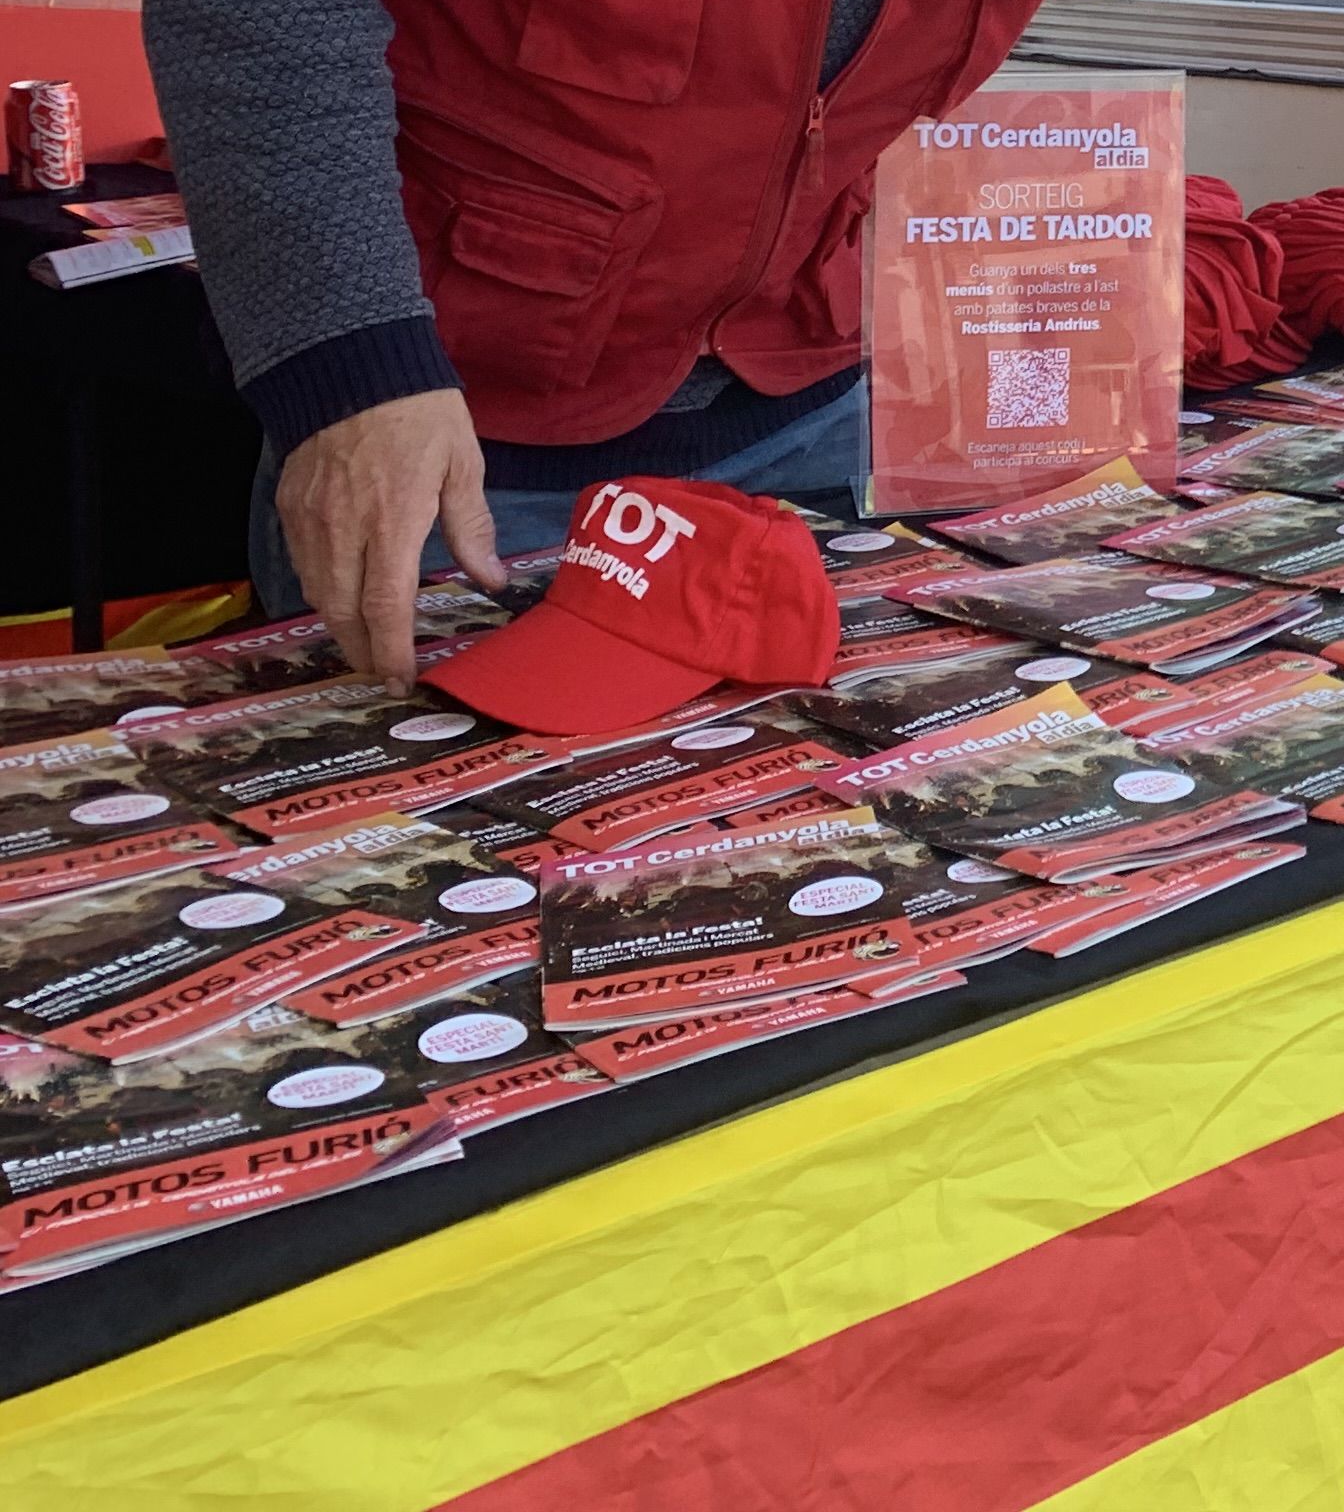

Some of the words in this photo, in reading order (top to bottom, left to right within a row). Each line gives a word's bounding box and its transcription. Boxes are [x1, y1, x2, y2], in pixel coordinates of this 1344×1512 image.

[913, 123, 979, 148] TOT
[981, 122, 1137, 153] Cerdanyola
[979, 183, 1084, 210] SORTEIG
[906, 216, 993, 243] FESTA
[1000, 215, 1037, 242] DE
[1043, 213, 1153, 241] TARDOR
[946, 284, 994, 297] menús
[1026, 281, 1081, 296] pollastre
[970, 263, 1017, 279] Guanya
[1020, 265, 1037, 276] un
[1039, 263, 1066, 275] dels
[1068, 262, 1097, 275] tres
[954, 302, 983, 316] amb
[985, 302, 1034, 317] patates
[1036, 300, 1078, 314] braves
[1080, 299, 1097, 312] de
[1099, 298, 1111, 311] la
[961, 319, 1042, 335] Rostisseria
[581, 483, 697, 564] TOT
[1000, 479, 1130, 527] Cerdanyola
[565, 538, 650, 601] Cerdanyola
[213, 632, 284, 654] TOT
[836, 758, 908, 789] TOT
[910, 707, 1072, 767] Cerdanyola
[266, 781, 404, 823] MOTOS
[582, 785, 706, 832] MOTOS
[556, 856, 643, 880] TOT
[646, 819, 850, 866] Cerdanyola
[571, 936, 660, 958] Esclata
[665, 929, 687, 941] la
[691, 916, 763, 936] Festa!
[84, 973, 236, 1039] MOTOS
[244, 919, 365, 973] FURIÓ
[324, 945, 472, 1004] MOTOS
[572, 965, 736, 1003] MOTOS
[753, 926, 890, 973] FURIÓ
[717, 977, 776, 996] YAMAHA
[444, 1057, 585, 1106] FURIÓ
[2, 1143, 114, 1174] Esclata
[23, 1162, 226, 1229] MOTOS
[247, 1114, 412, 1176] FURIÓ
[210, 1184, 284, 1210] YAMAHA
